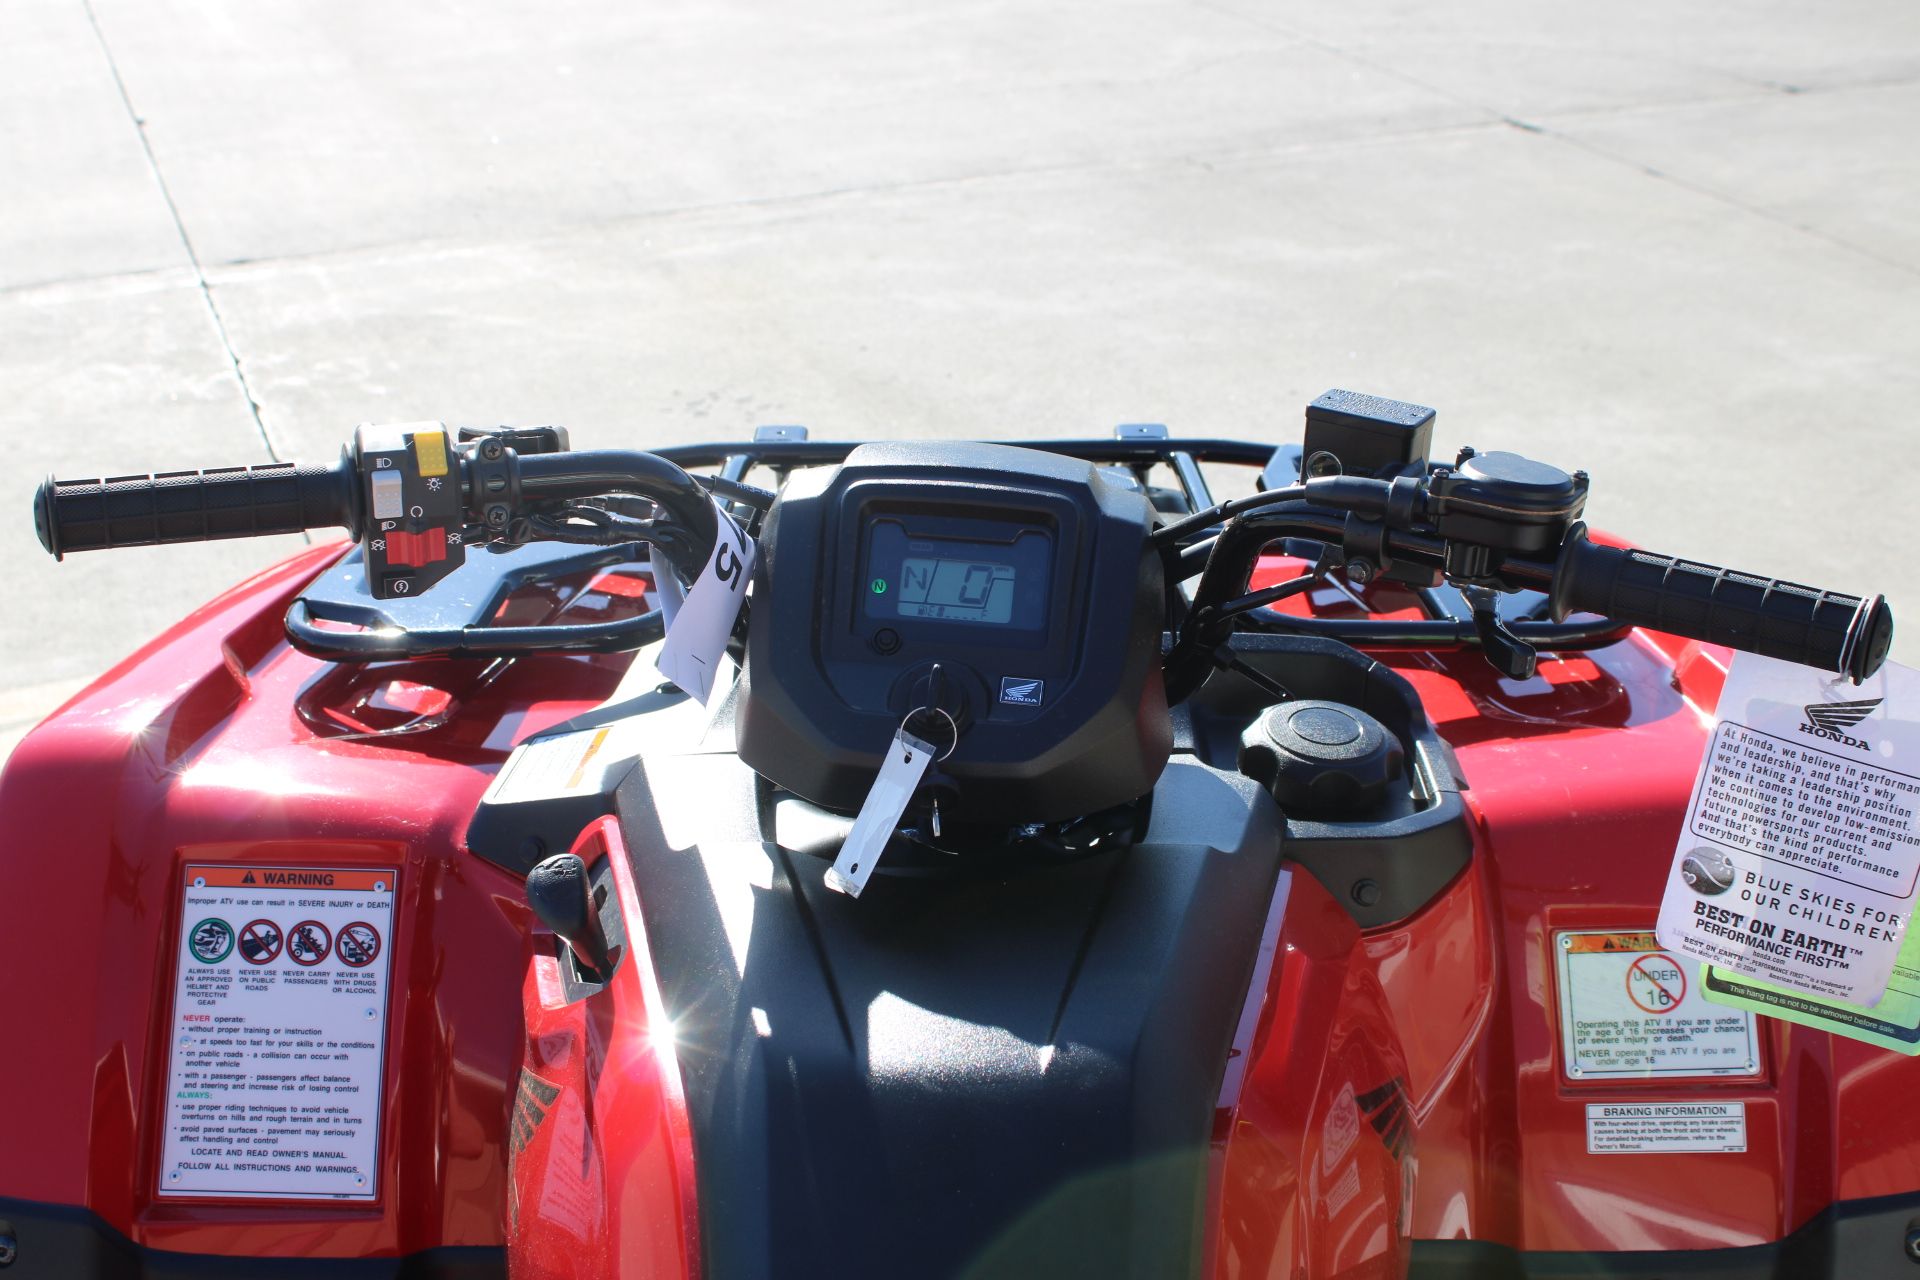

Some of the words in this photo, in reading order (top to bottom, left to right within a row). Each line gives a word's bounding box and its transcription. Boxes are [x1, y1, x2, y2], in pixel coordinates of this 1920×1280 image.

[874, 581, 884, 591] N
[904, 566, 928, 590] N
[958, 564, 993, 605] 0
[1004, 696, 1038, 704] HONDA
[1723, 727, 1735, 739] At
[1740, 732, 1775, 753] Honda,
[1782, 747, 1796, 758] we
[1800, 751, 1840, 771] believe
[1845, 764, 1856, 776] in
[1799, 723, 1871, 751] HONDA
[1717, 753, 1746, 768] we're
[1751, 763, 1785, 782] taking
[1789, 776, 1796, 784] a
[1801, 777, 1859, 803] leadership
[1864, 798, 1911, 817] position
[1720, 741, 1740, 753] and
[1743, 747, 1804, 774] leadership,
[1810, 769, 1831, 781] and
[1835, 775, 1869, 793] that's
[1874, 788, 1895, 801] why
[1711, 774, 1725, 787] We
[1730, 783, 1777, 803] continue
[1782, 797, 1793, 808] to
[1798, 803, 1840, 822] develop
[1714, 765, 1740, 779] when
[1744, 773, 1753, 784] it
[1758, 779, 1793, 795] comes
[1798, 789, 1809, 800] to
[1814, 794, 1831, 807] the
[1836, 803, 1909, 830] environment.
[1704, 797, 1737, 816] future
[1741, 812, 1808, 838] powersports
[1813, 834, 1866, 856] products.
[1708, 787, 1775, 816] technologies
[1781, 809, 1797, 822] for
[1801, 817, 1820, 828] our
[1824, 824, 1866, 843] current
[1871, 839, 1892, 850] and
[1698, 822, 1751, 846] everybody
[1755, 841, 1774, 852] can
[1779, 848, 1841, 873] appreciate.
[1700, 809, 1720, 823] And
[1724, 817, 1756, 835] that's
[1762, 829, 1779, 841] the
[1784, 835, 1808, 850] kind
[1812, 846, 1824, 854] of
[1827, 851, 1898, 877] performance
[263, 872, 333, 885] WARNING
[297, 899, 325, 907] SEVERE
[1745, 871, 1792, 895] BLUE
[1799, 888, 1854, 913] SKIES
[1862, 907, 1899, 925] FOR
[1693, 900, 1743, 927] BEST
[1749, 919, 1775, 938] ON
[1740, 889, 1780, 910] OUR
[1788, 903, 1894, 941] CHILDREN
[1696, 918, 1791, 957] PERFORMANCE
[1752, 950, 1785, 964] honda.com
[1633, 970, 1679, 981] UNDER
[1647, 989, 1671, 1006] 16
[1729, 984, 1745, 994] This
[1746, 988, 1764, 1000] hang
[1766, 994, 1778, 1003] tag
[1808, 1004, 1819, 1012] be
[1820, 1008, 1852, 1021] removed
[1853, 1016, 1877, 1028] before
[243, 1027, 270, 1035] training
[1576, 1020, 1618, 1029] Operating
[1623, 1019, 1639, 1027] this
[1644, 1018, 1660, 1026] ATV
[1665, 1018, 1671, 1026] if
[1714, 1016, 1739, 1024] under
[1576, 1028, 1590, 1036] the
[1595, 1029, 1610, 1037] age
[1614, 1027, 1624, 1035] of
[1629, 1027, 1639, 1035] 16
[1643, 1026, 1684, 1034] increases
[1577, 1036, 1586, 1044] of
[1590, 1036, 1619, 1044] severe
[1624, 1035, 1648, 1044] injury
[1666, 1033, 1693, 1041] death.
[1603, 1107, 1651, 1116] BRAKING
[1654, 1106, 1726, 1115] INFORMATION
[177, 1161, 211, 1169] FOLLOW
[233, 1163, 290, 1171] INSTRUCTIONS
[315, 1165, 358, 1173] WARNINGS.
